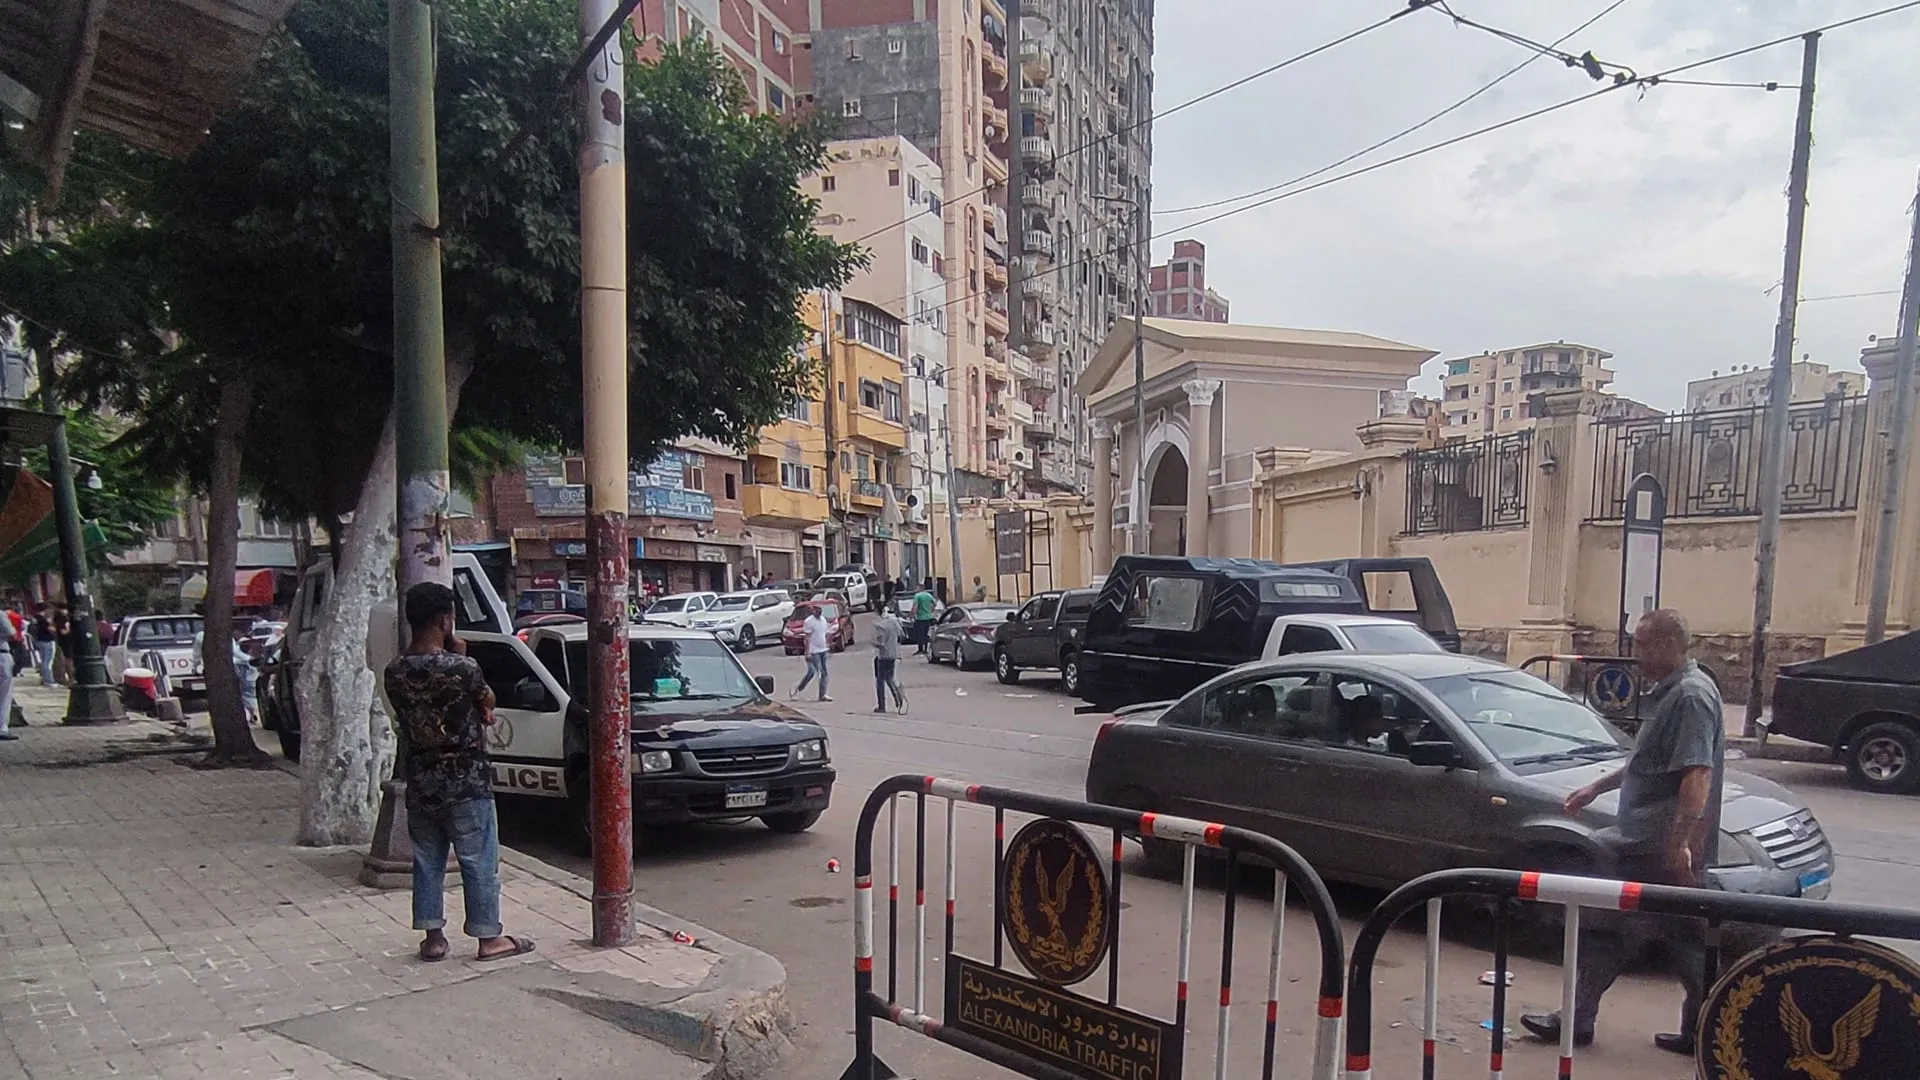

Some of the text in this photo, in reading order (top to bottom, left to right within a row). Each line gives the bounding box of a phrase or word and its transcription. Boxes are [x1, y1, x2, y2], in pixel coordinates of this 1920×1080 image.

[491, 767, 560, 791] LICE
[1061, 1015, 1105, 1038] مرور
[963, 1001, 1153, 1080] ALEXANDRIA TRAFFIC
